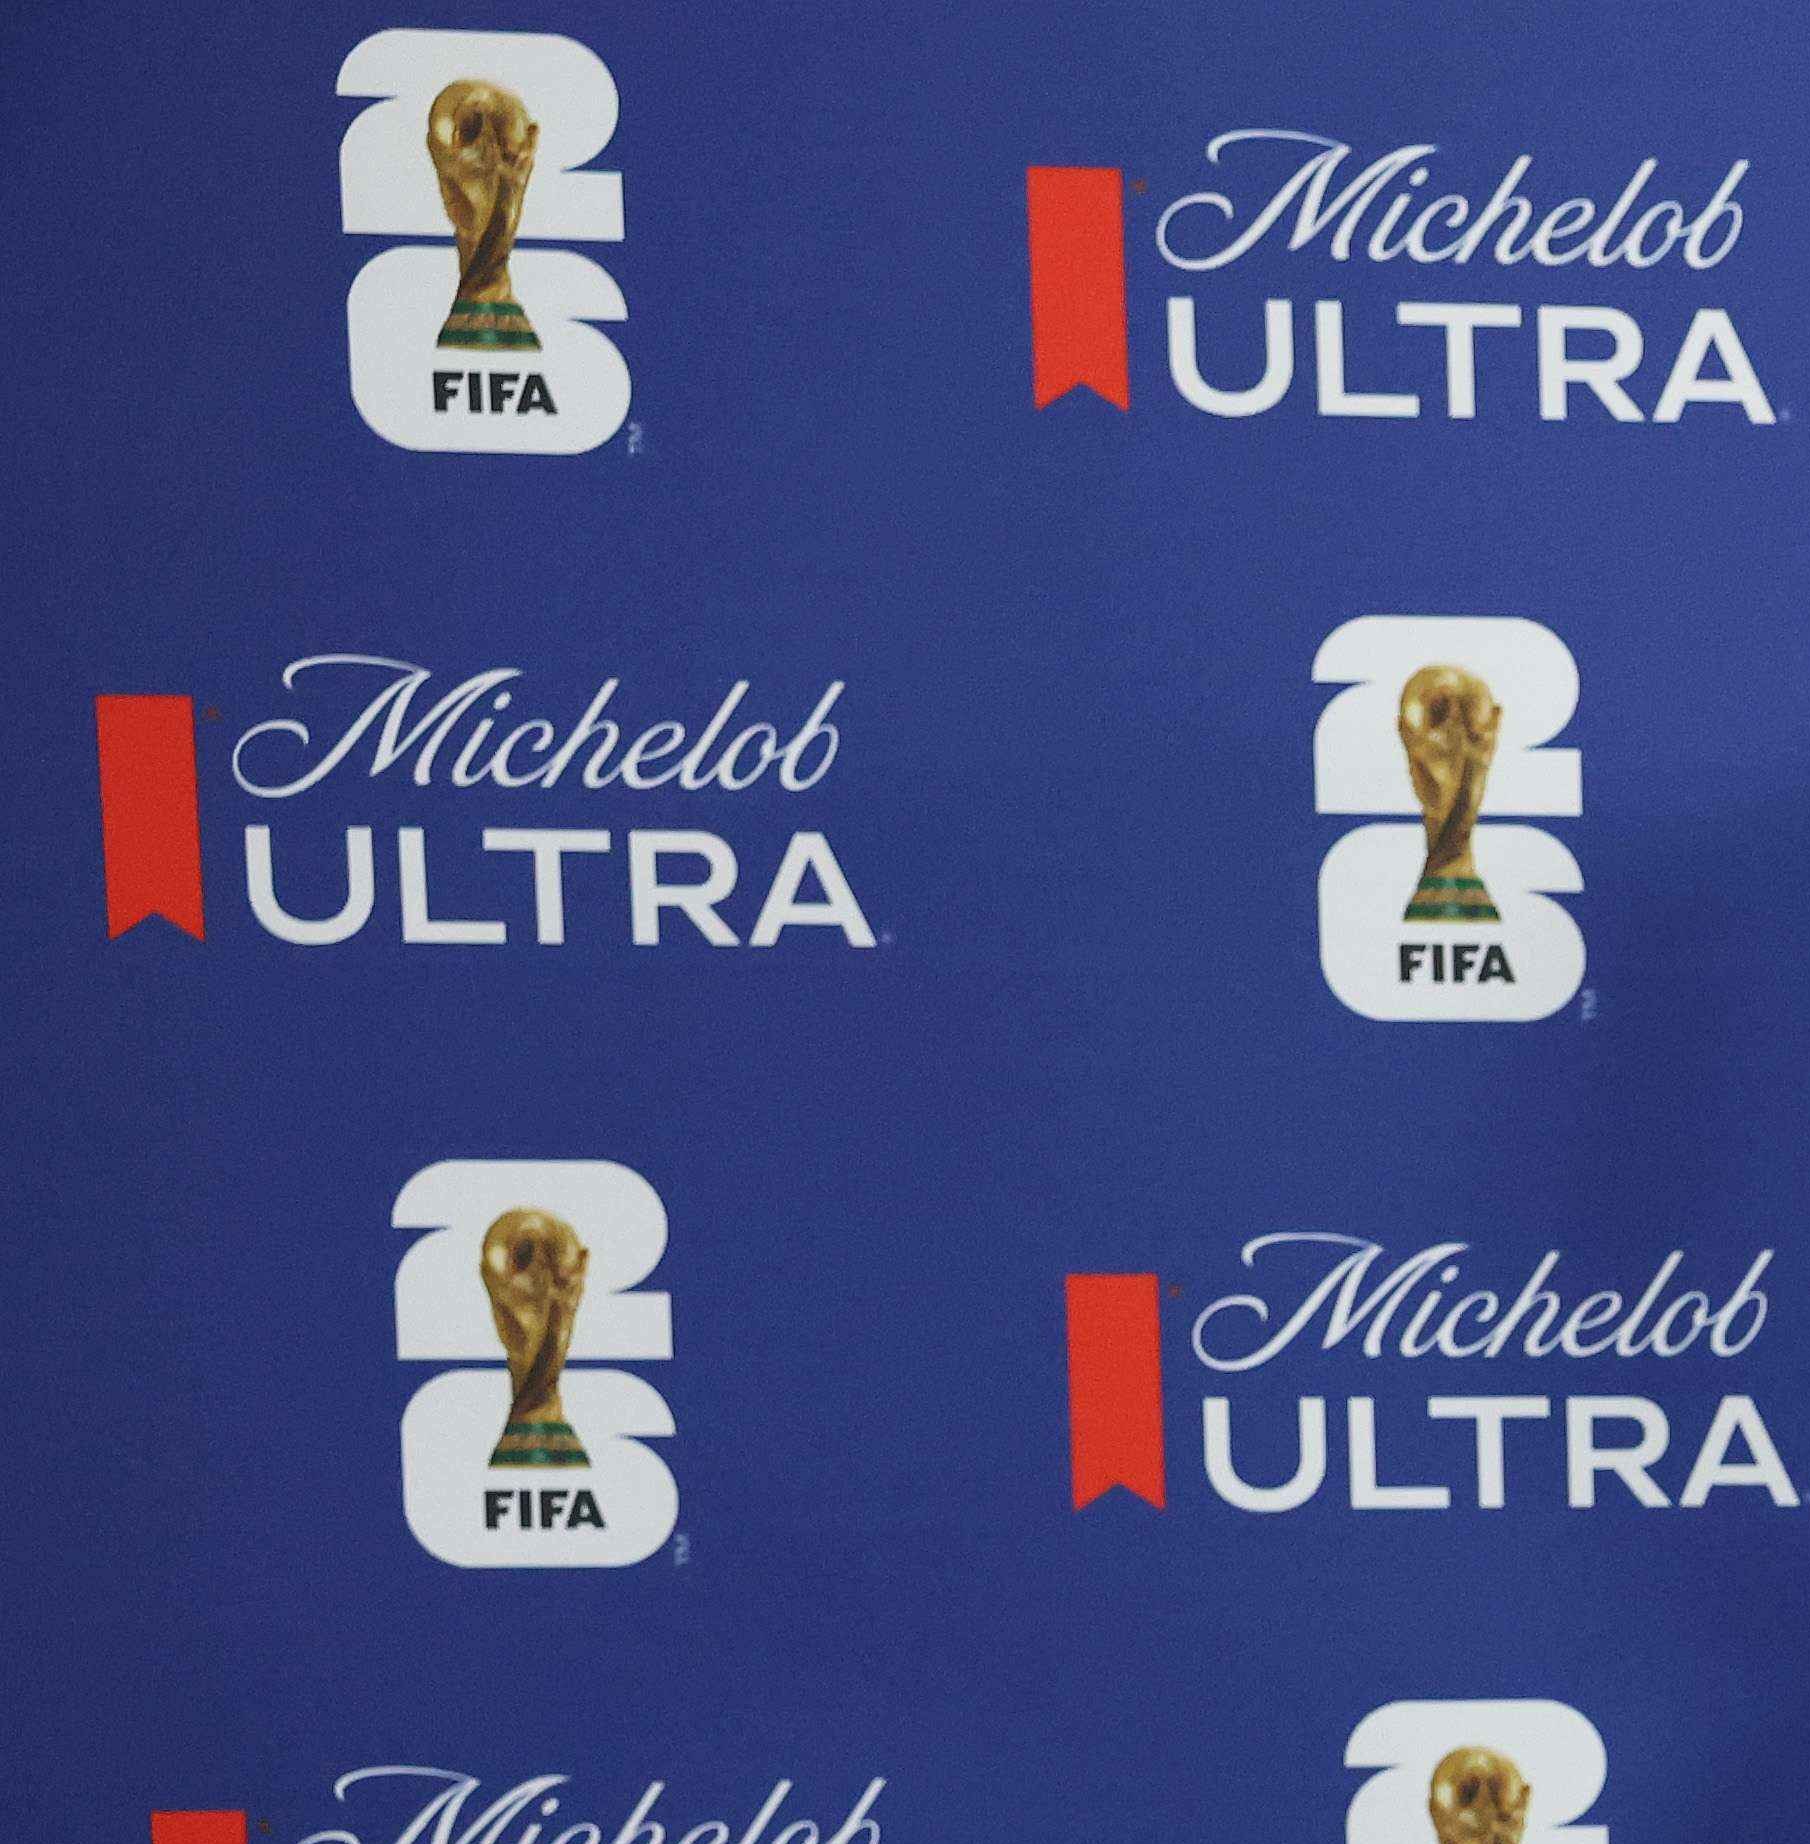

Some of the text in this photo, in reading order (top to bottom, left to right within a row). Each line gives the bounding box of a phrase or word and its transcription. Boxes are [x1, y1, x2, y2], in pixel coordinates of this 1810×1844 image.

[1156, 130, 1749, 270] Michelob
[432, 370, 558, 415] FIFA
[1167, 297, 1776, 424] ULTRA
[232, 654, 844, 797] Michelob
[245, 825, 876, 947] ULTRA
[1398, 943, 1516, 984] FIFA
[1192, 1233, 1773, 1371] Michelob
[483, 1489, 606, 1530] FIFA
[1203, 1396, 1800, 1512] ULTRA
